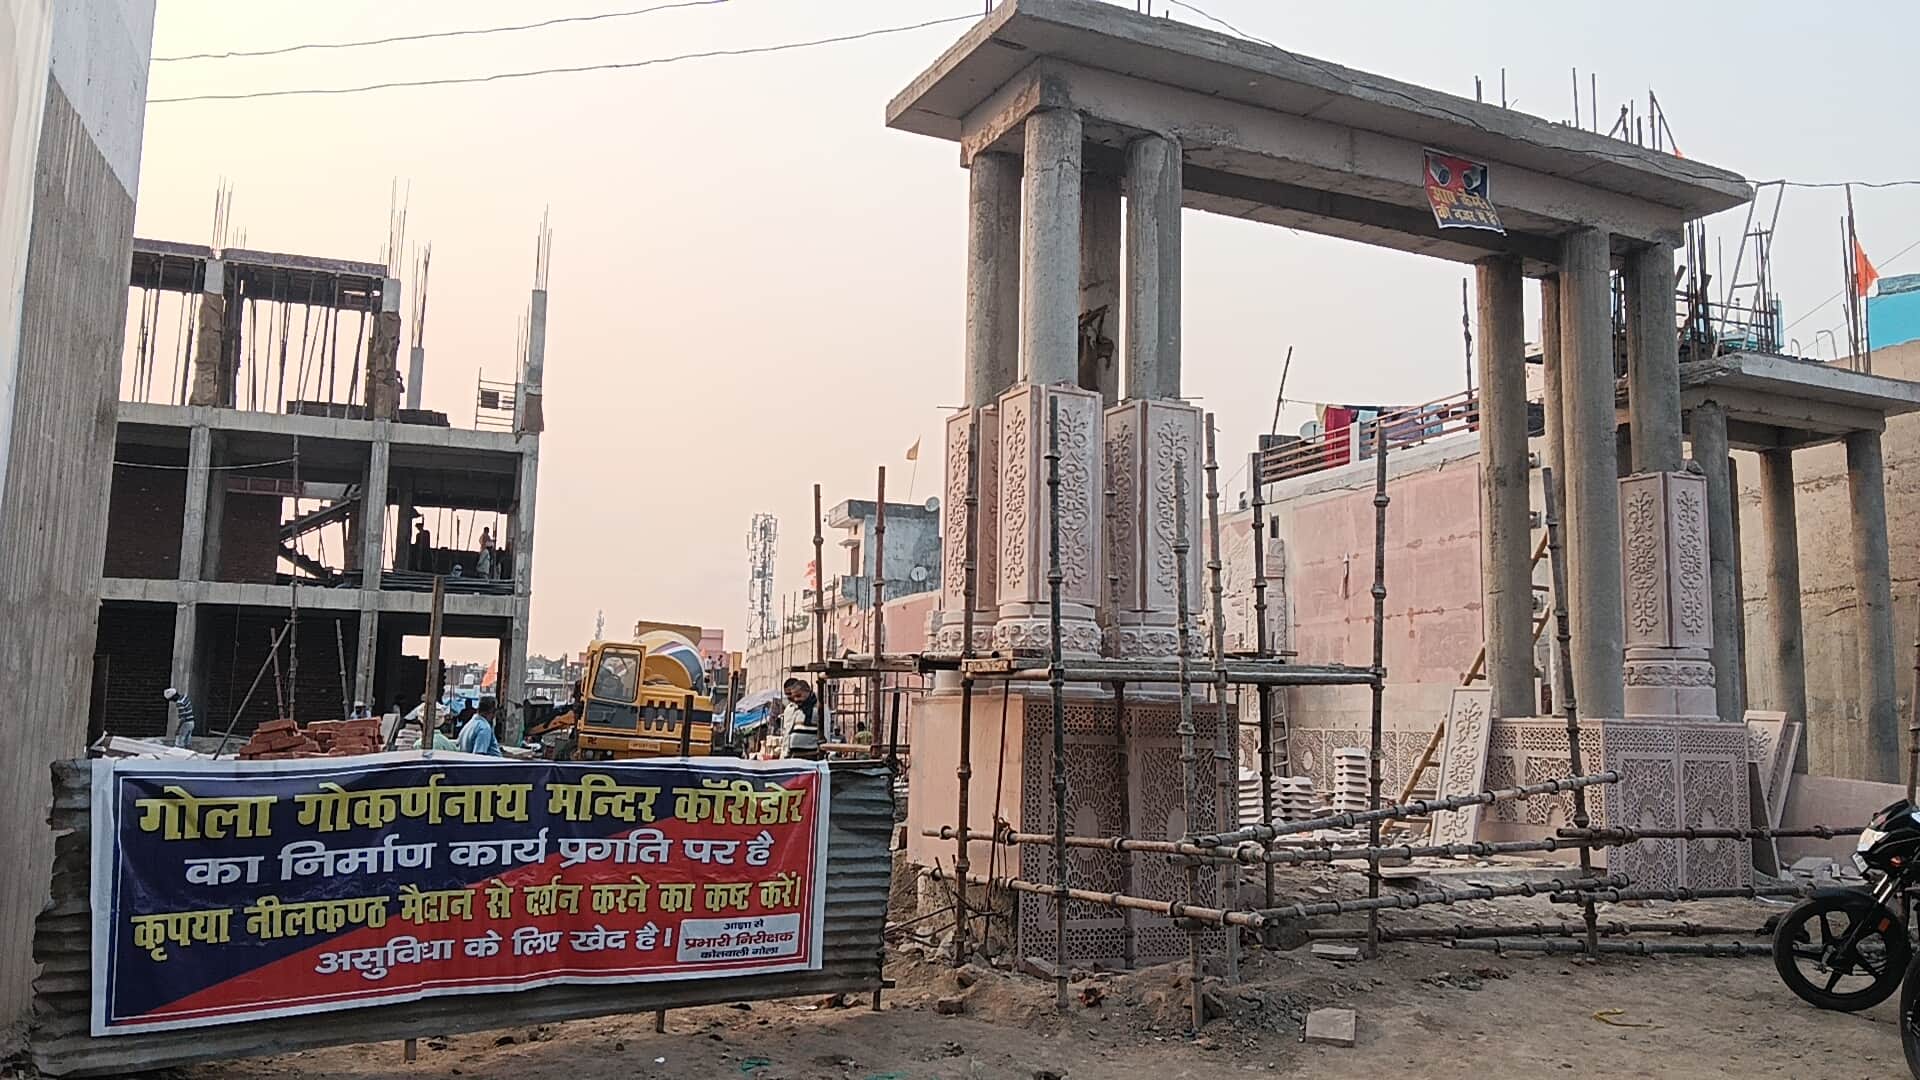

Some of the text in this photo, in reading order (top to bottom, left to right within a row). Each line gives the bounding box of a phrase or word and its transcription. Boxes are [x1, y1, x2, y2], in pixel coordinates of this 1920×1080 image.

[135, 773, 806, 841] गोला गोकर्णनाथ मन्दिर कॉरीडोर
[184, 827, 774, 886] का निर्माण कार्य प्रगति पर है
[131, 908, 233, 961] कृपया
[244, 895, 390, 940] नीलकण्ठ
[398, 884, 475, 924] मैदान
[485, 876, 513, 919] से
[524, 875, 583, 916] दर्शन
[590, 875, 650, 914] करने
[658, 882, 696, 913] का
[703, 882, 753, 913] कष्ट
[685, 930, 795, 950] प्रभारी निरीक्षक
[754, 918, 764, 928] से
[314, 936, 455, 980] असुविधा
[464, 929, 502, 958] के
[512, 926, 563, 956] लिए
[569, 924, 627, 951] खेद
[701, 946, 749, 958] कोतवाली
